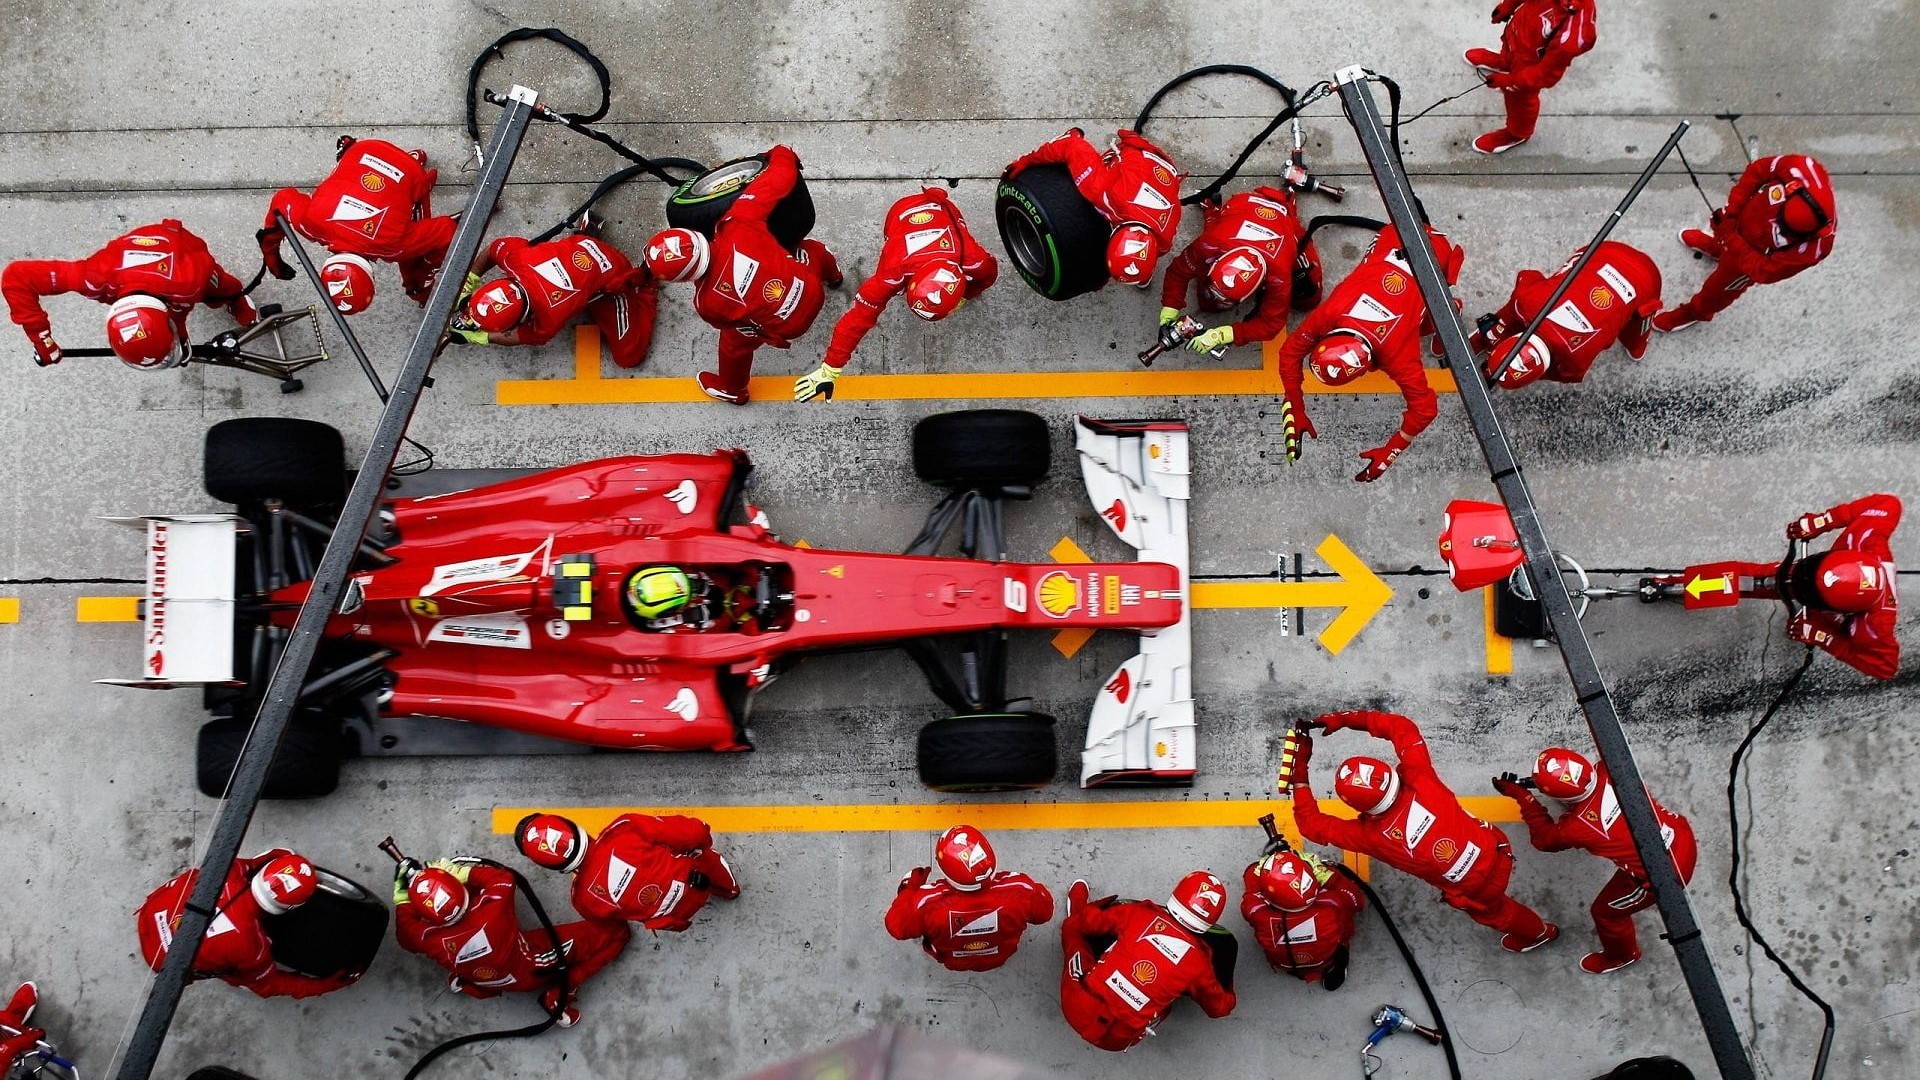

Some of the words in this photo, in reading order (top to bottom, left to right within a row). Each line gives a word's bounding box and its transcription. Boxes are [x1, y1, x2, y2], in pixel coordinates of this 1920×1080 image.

[784, 281, 801, 312] Santander
[149, 525, 168, 645] Santander
[1004, 577, 1027, 613] 6
[1121, 584, 1141, 605] FIAT
[1455, 847, 1476, 876] Santander
[1117, 981, 1144, 1006] Santander
